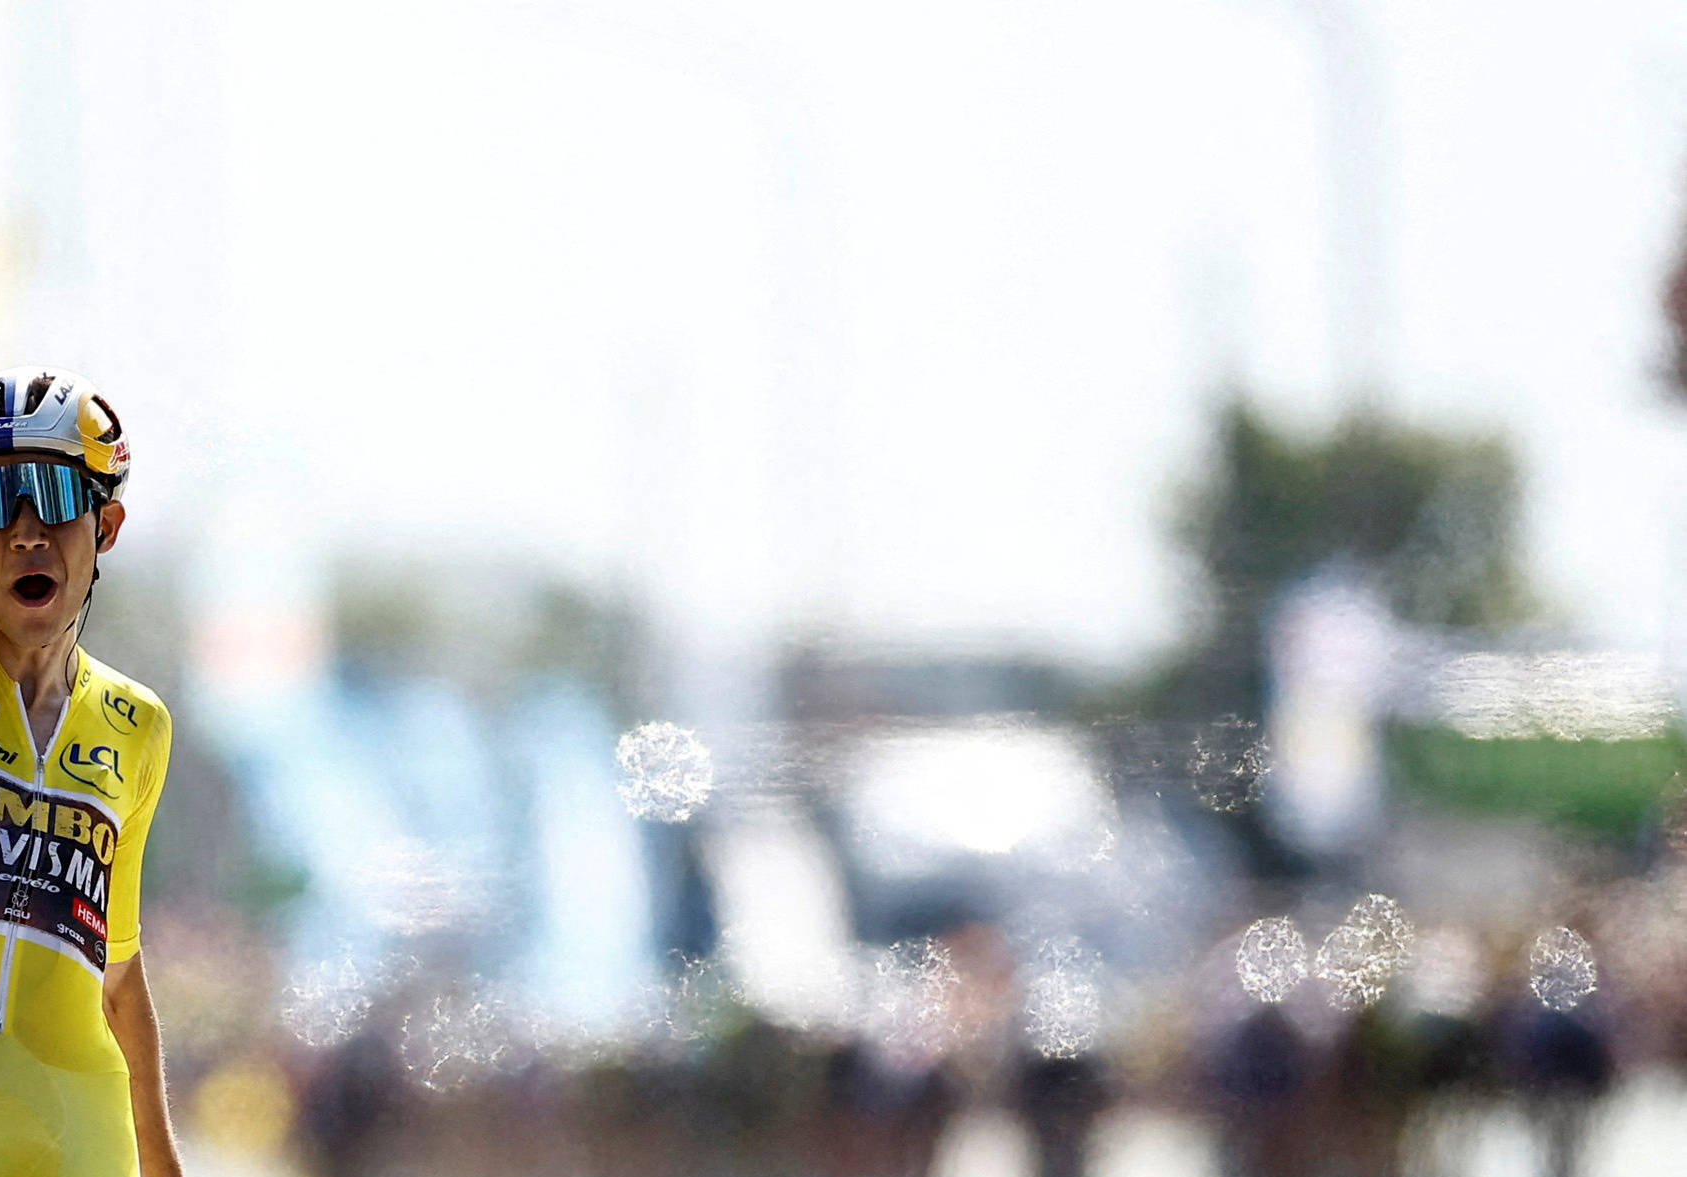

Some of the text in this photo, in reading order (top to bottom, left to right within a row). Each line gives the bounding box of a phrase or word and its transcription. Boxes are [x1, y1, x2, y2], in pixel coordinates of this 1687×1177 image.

[105, 689, 138, 728] LCL
[69, 743, 124, 784] LCL
[4, 908, 31, 919] AGU
[77, 904, 106, 937] HEMA
[56, 923, 85, 945] graze
